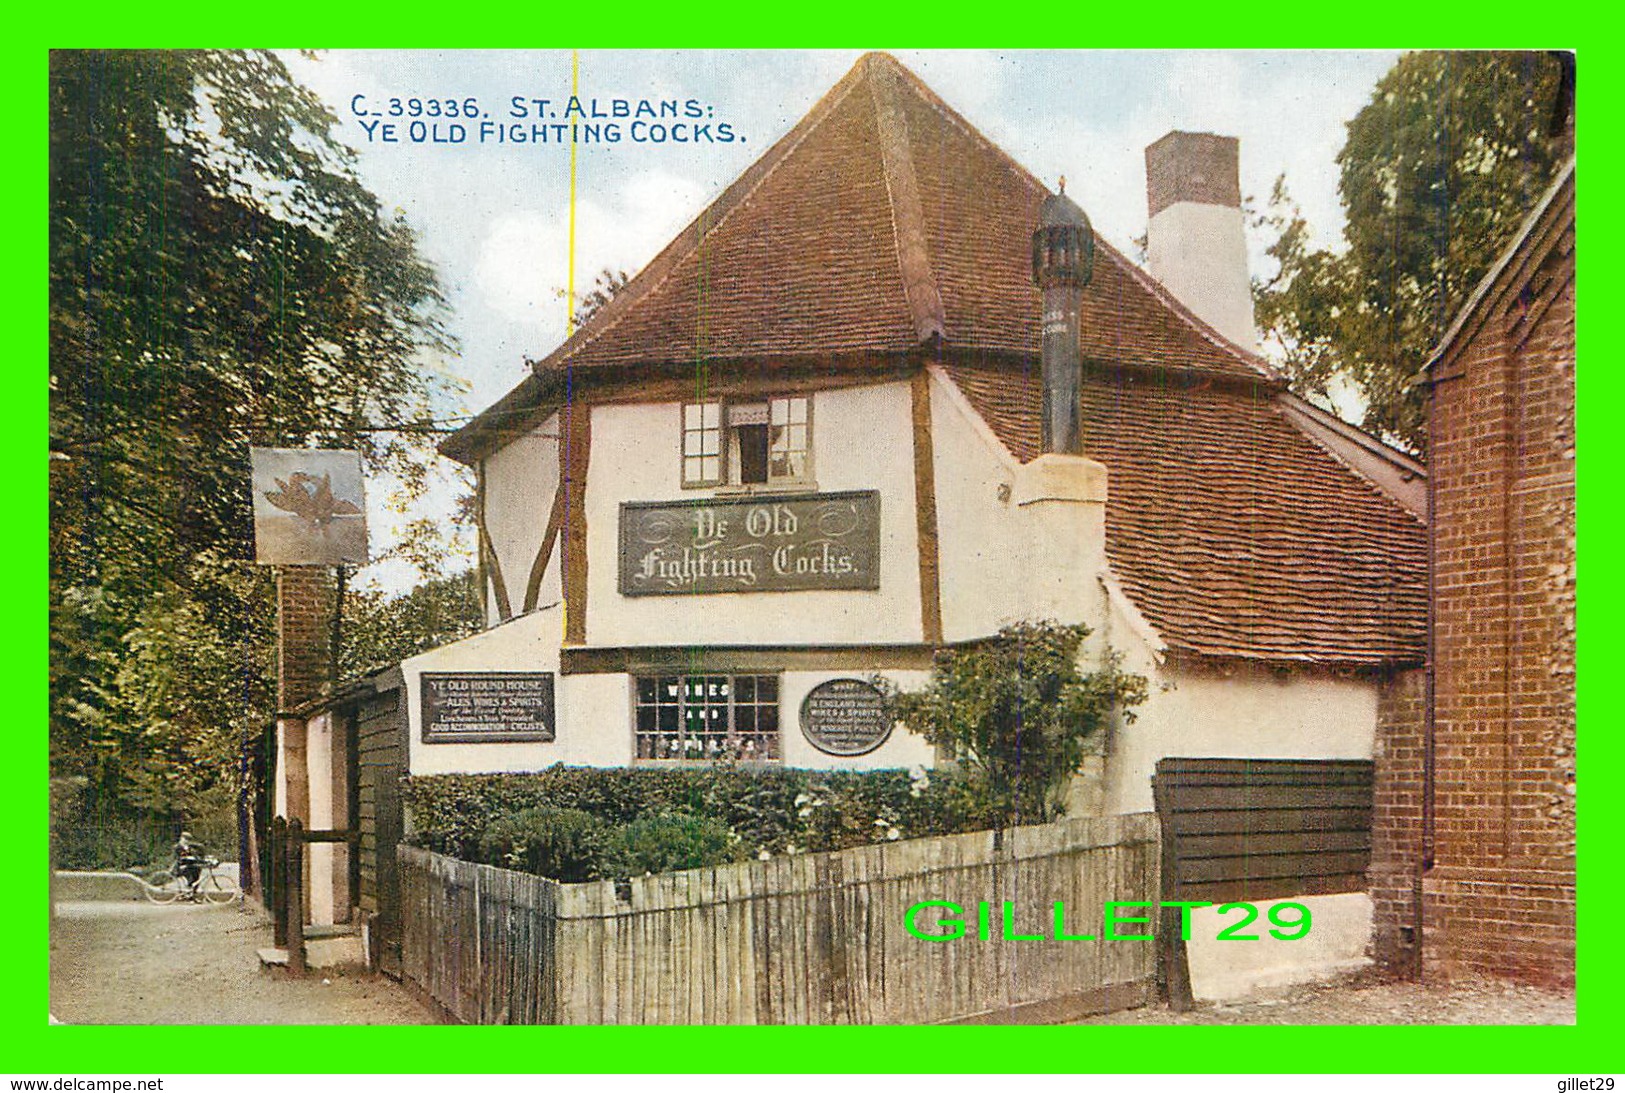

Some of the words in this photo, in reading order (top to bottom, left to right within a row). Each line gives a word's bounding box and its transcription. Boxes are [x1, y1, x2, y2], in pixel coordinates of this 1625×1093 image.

[745, 504, 799, 538] Old
[634, 545, 757, 587] Fighting
[772, 542, 859, 578] Cocks.
[447, 681, 469, 690] OLD
[471, 681, 504, 690] ROUND
[506, 681, 542, 690] HOUSE
[667, 684, 730, 697] WINES
[686, 710, 719, 720] AND
